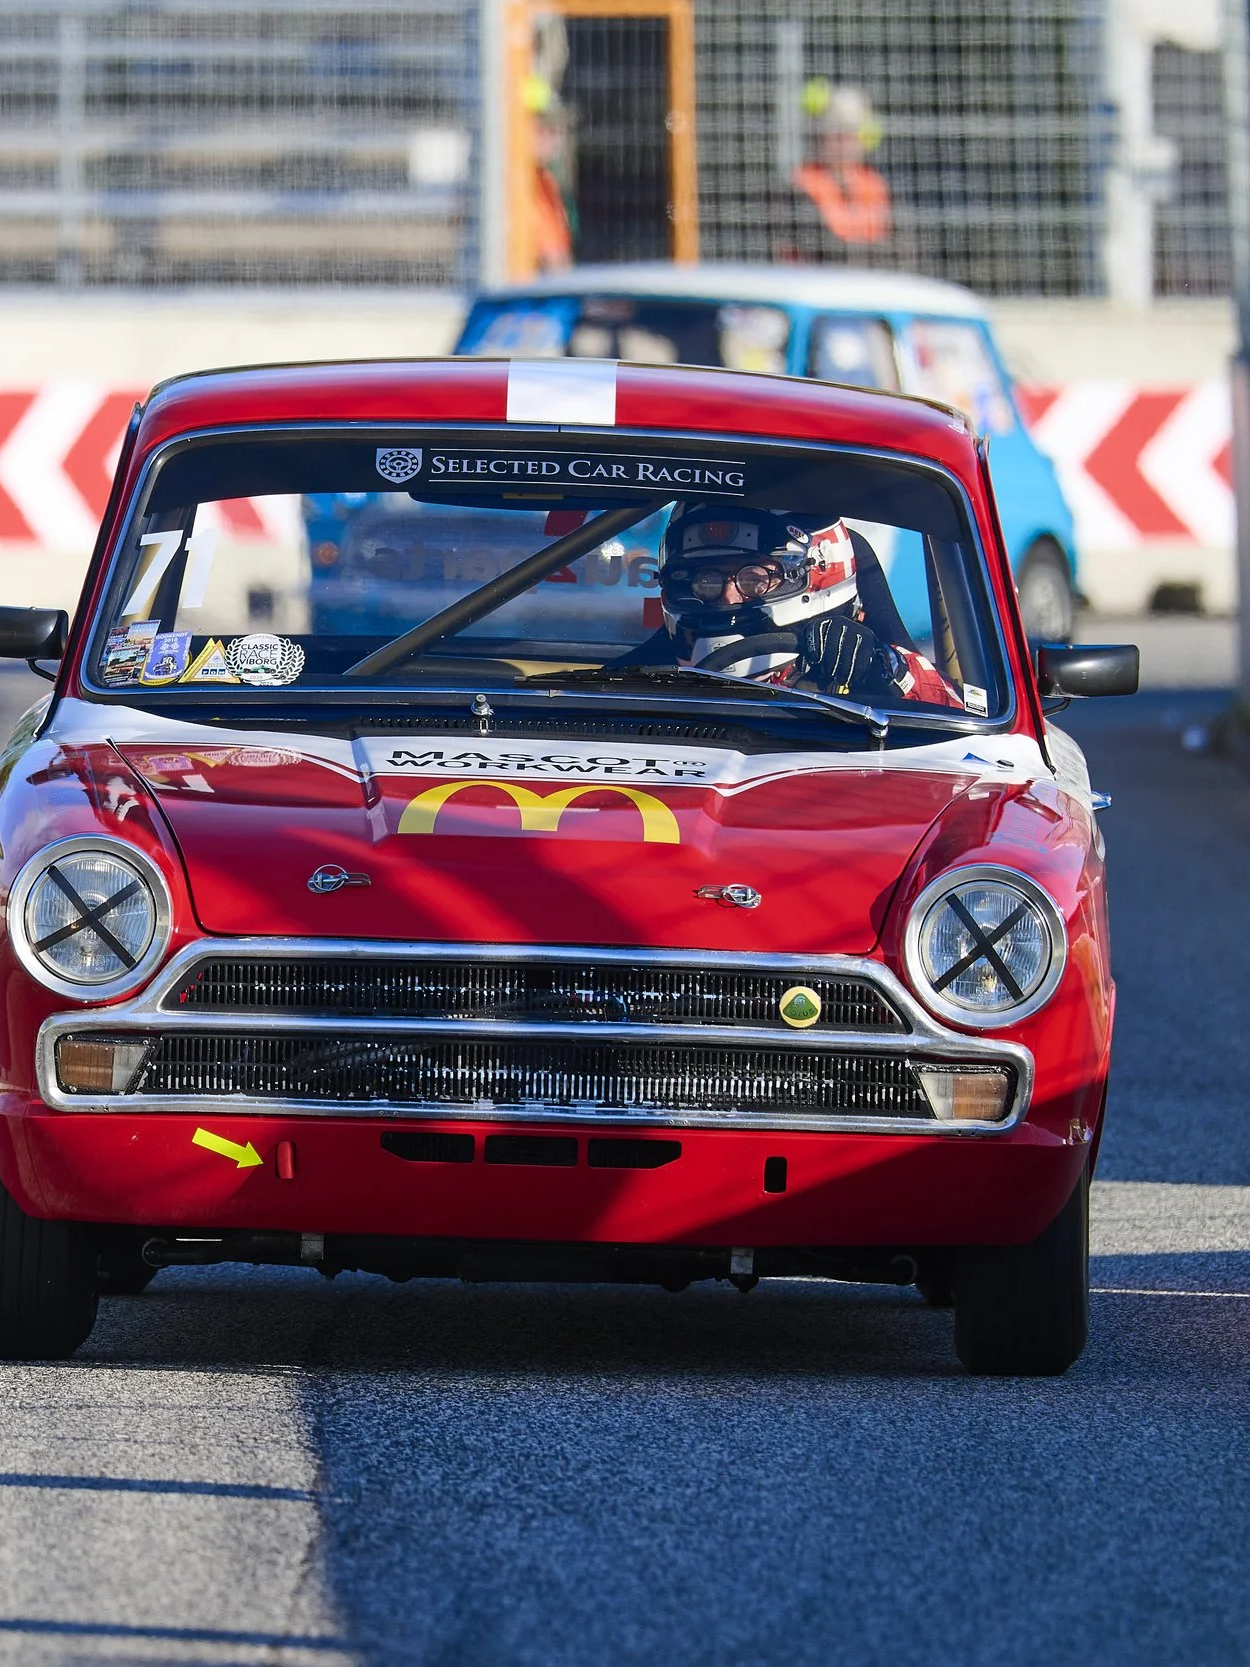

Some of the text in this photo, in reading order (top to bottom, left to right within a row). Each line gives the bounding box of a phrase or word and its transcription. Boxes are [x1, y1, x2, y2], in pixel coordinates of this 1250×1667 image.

[430, 456, 746, 488] SELECTED CAR RACING
[121, 528, 217, 617] 71
[239, 649, 278, 660] RACE
[385, 759, 707, 778] WORKWEAR
